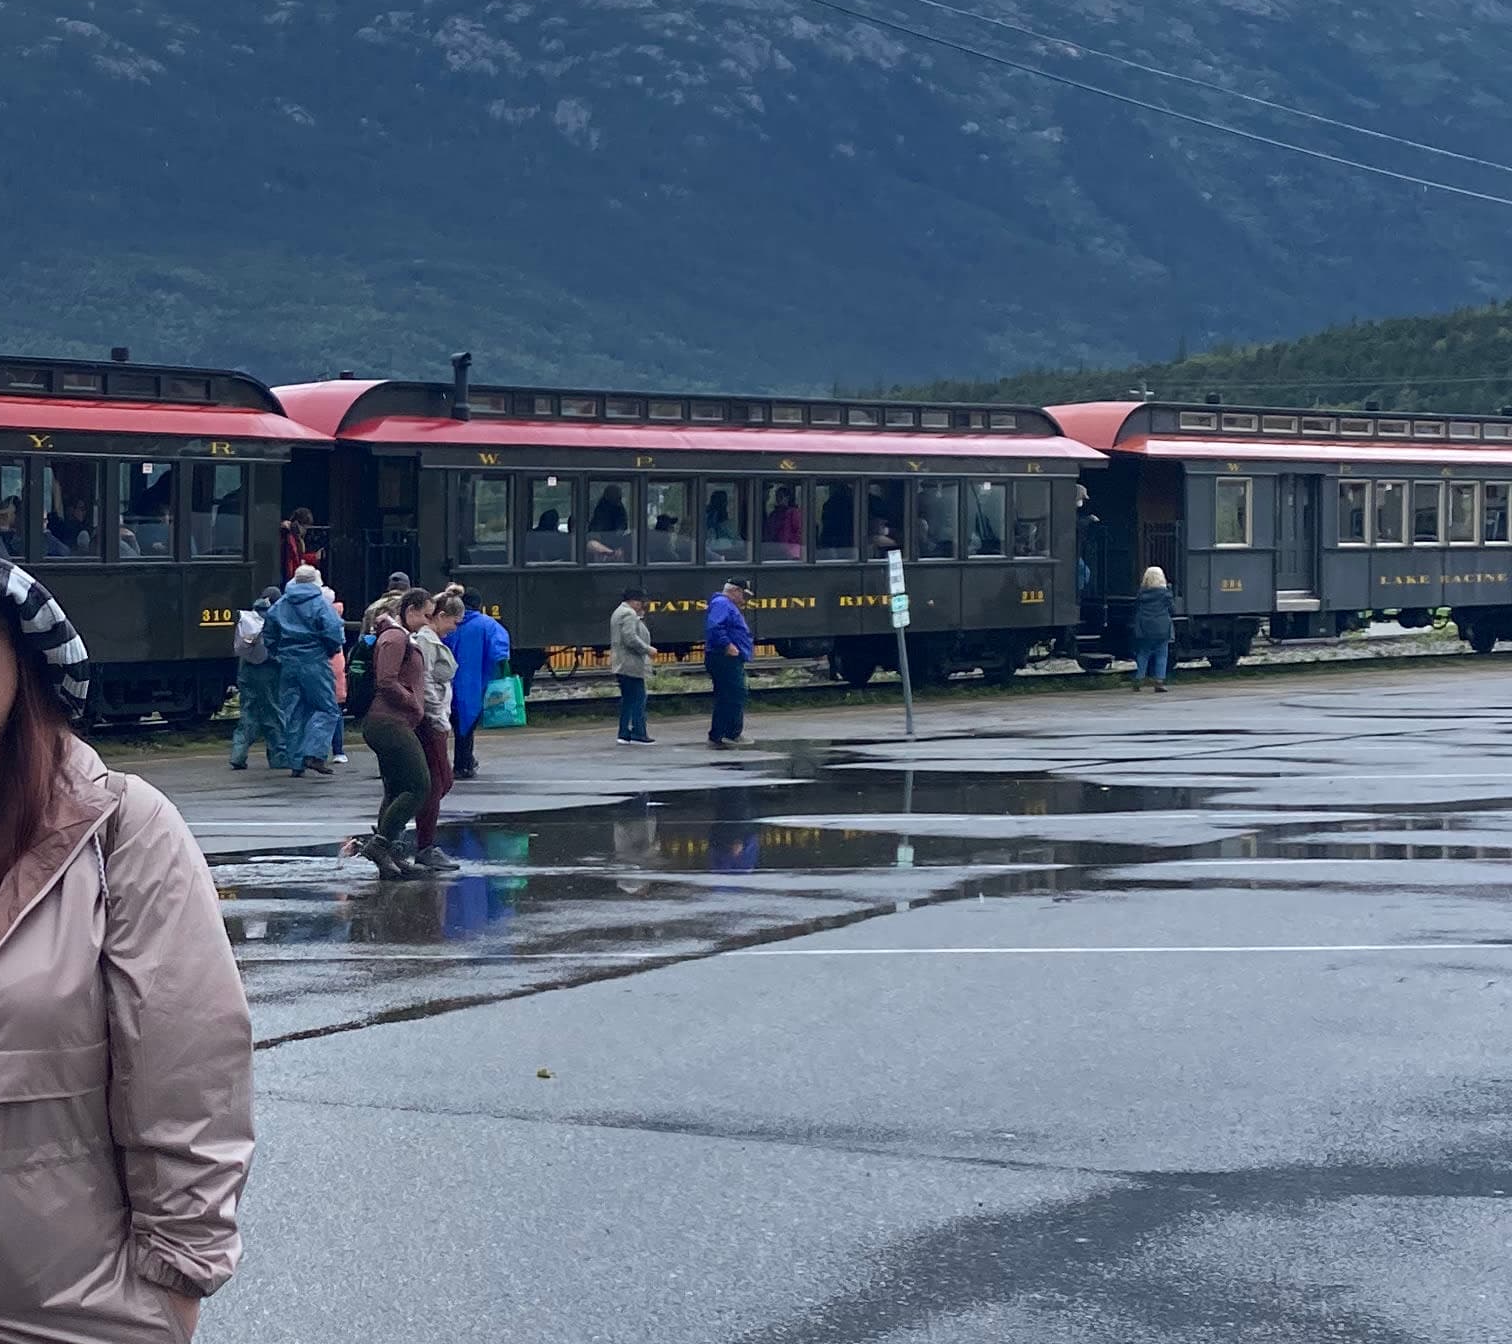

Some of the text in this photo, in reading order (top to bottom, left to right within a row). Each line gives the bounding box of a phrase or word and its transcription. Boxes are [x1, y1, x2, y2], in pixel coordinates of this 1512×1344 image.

[28, 434, 54, 449] Y.
[1380, 575, 1430, 585] LAKE
[202, 609, 232, 622] 310
